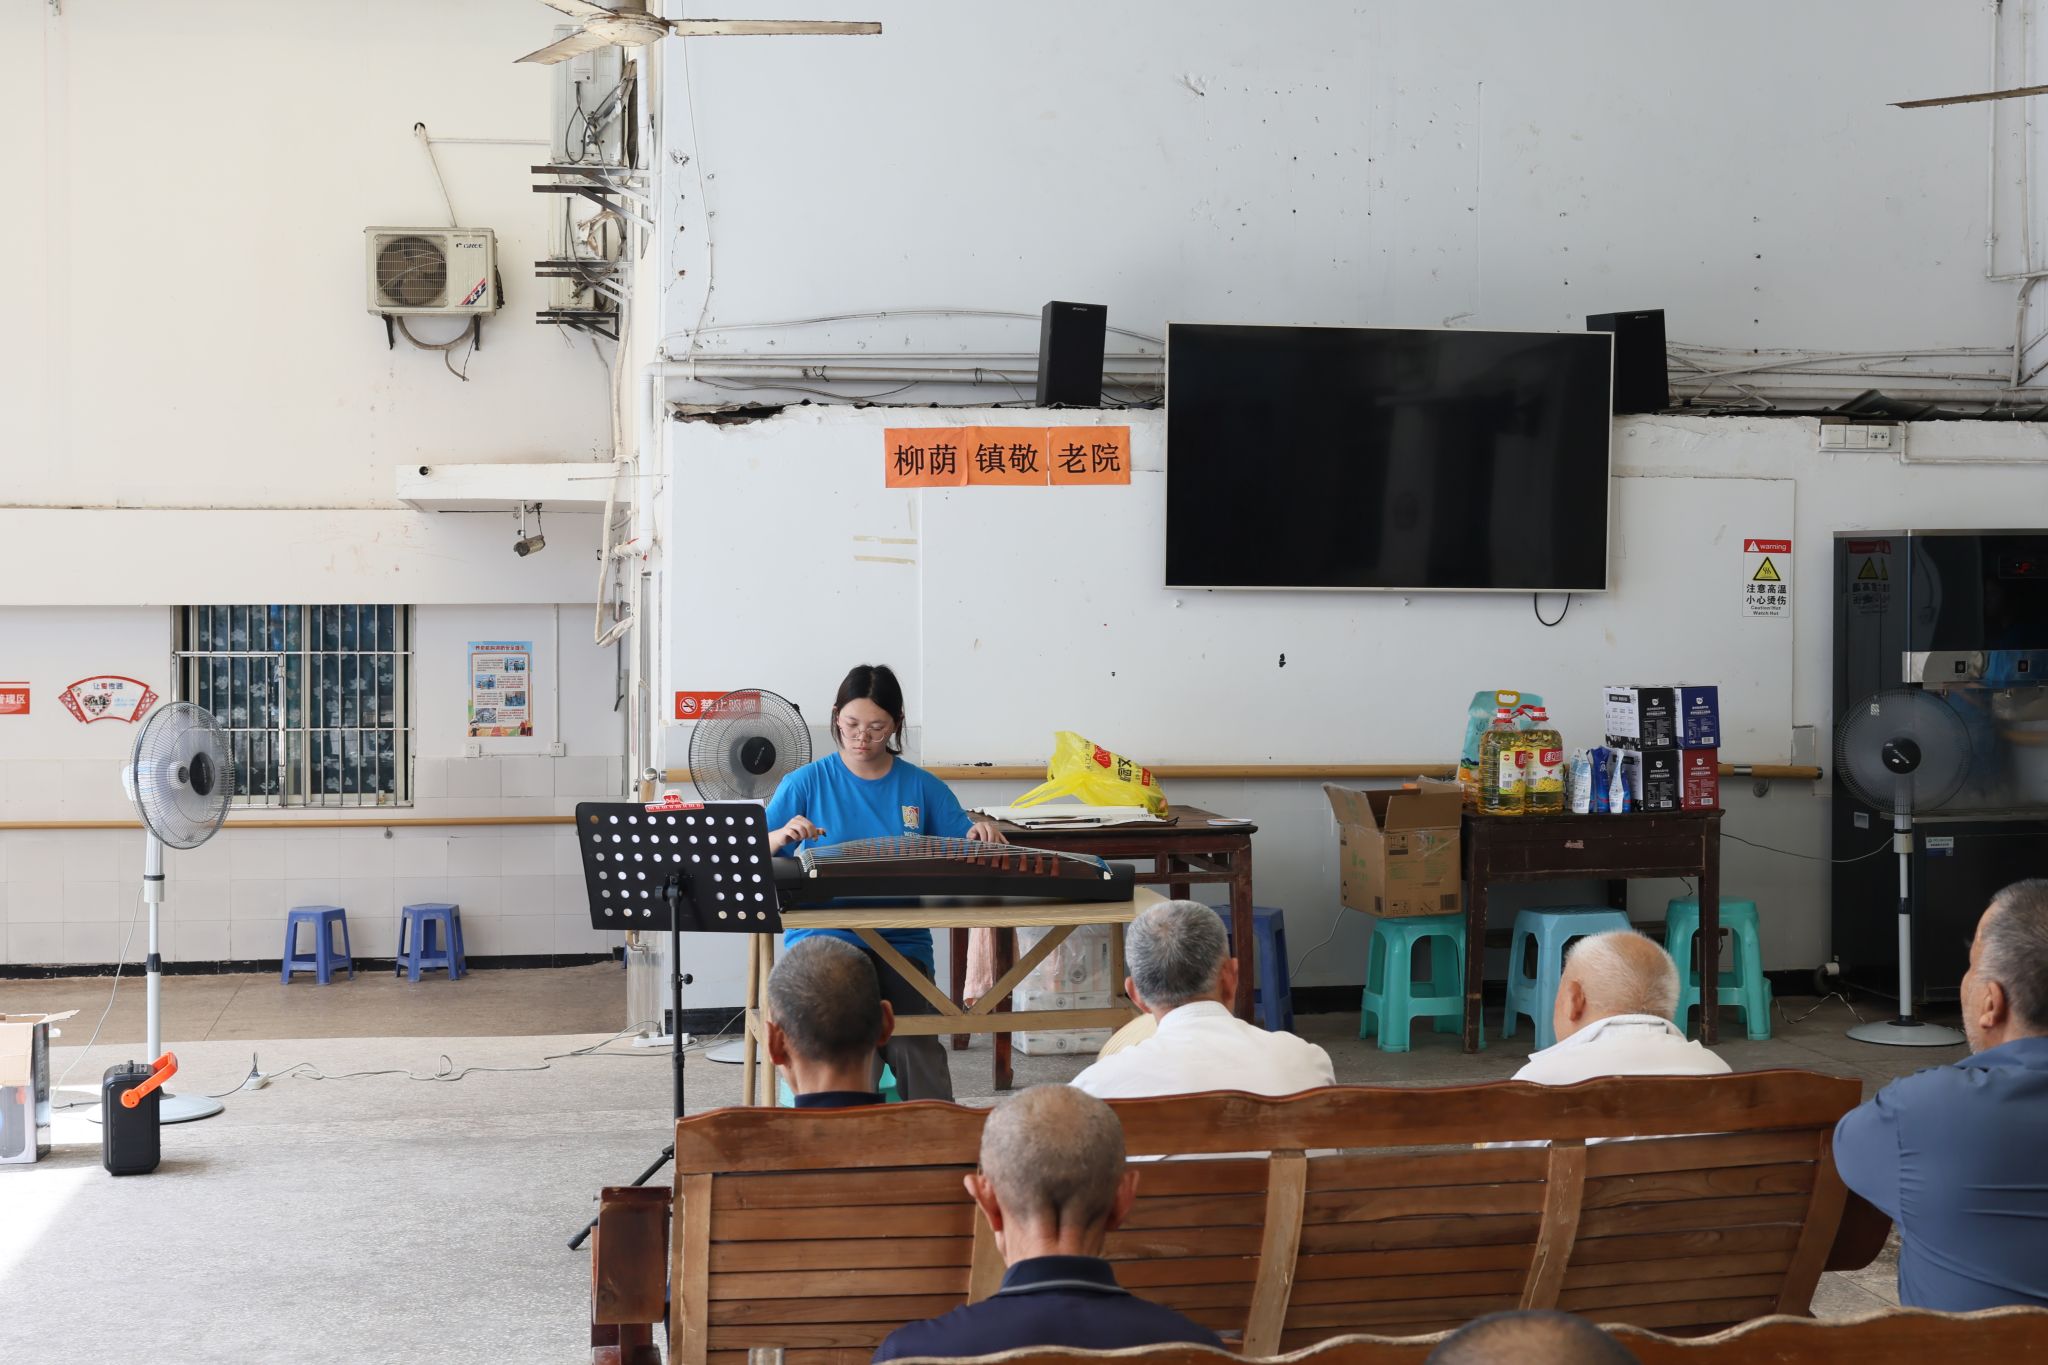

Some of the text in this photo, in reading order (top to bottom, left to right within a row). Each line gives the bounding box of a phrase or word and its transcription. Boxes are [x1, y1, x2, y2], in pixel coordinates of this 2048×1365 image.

[893, 442, 1121, 476] 柳荫镇敬老院
[1746, 584, 1787, 594] 注意高温
[1746, 595, 1787, 605] 小心烫伤
